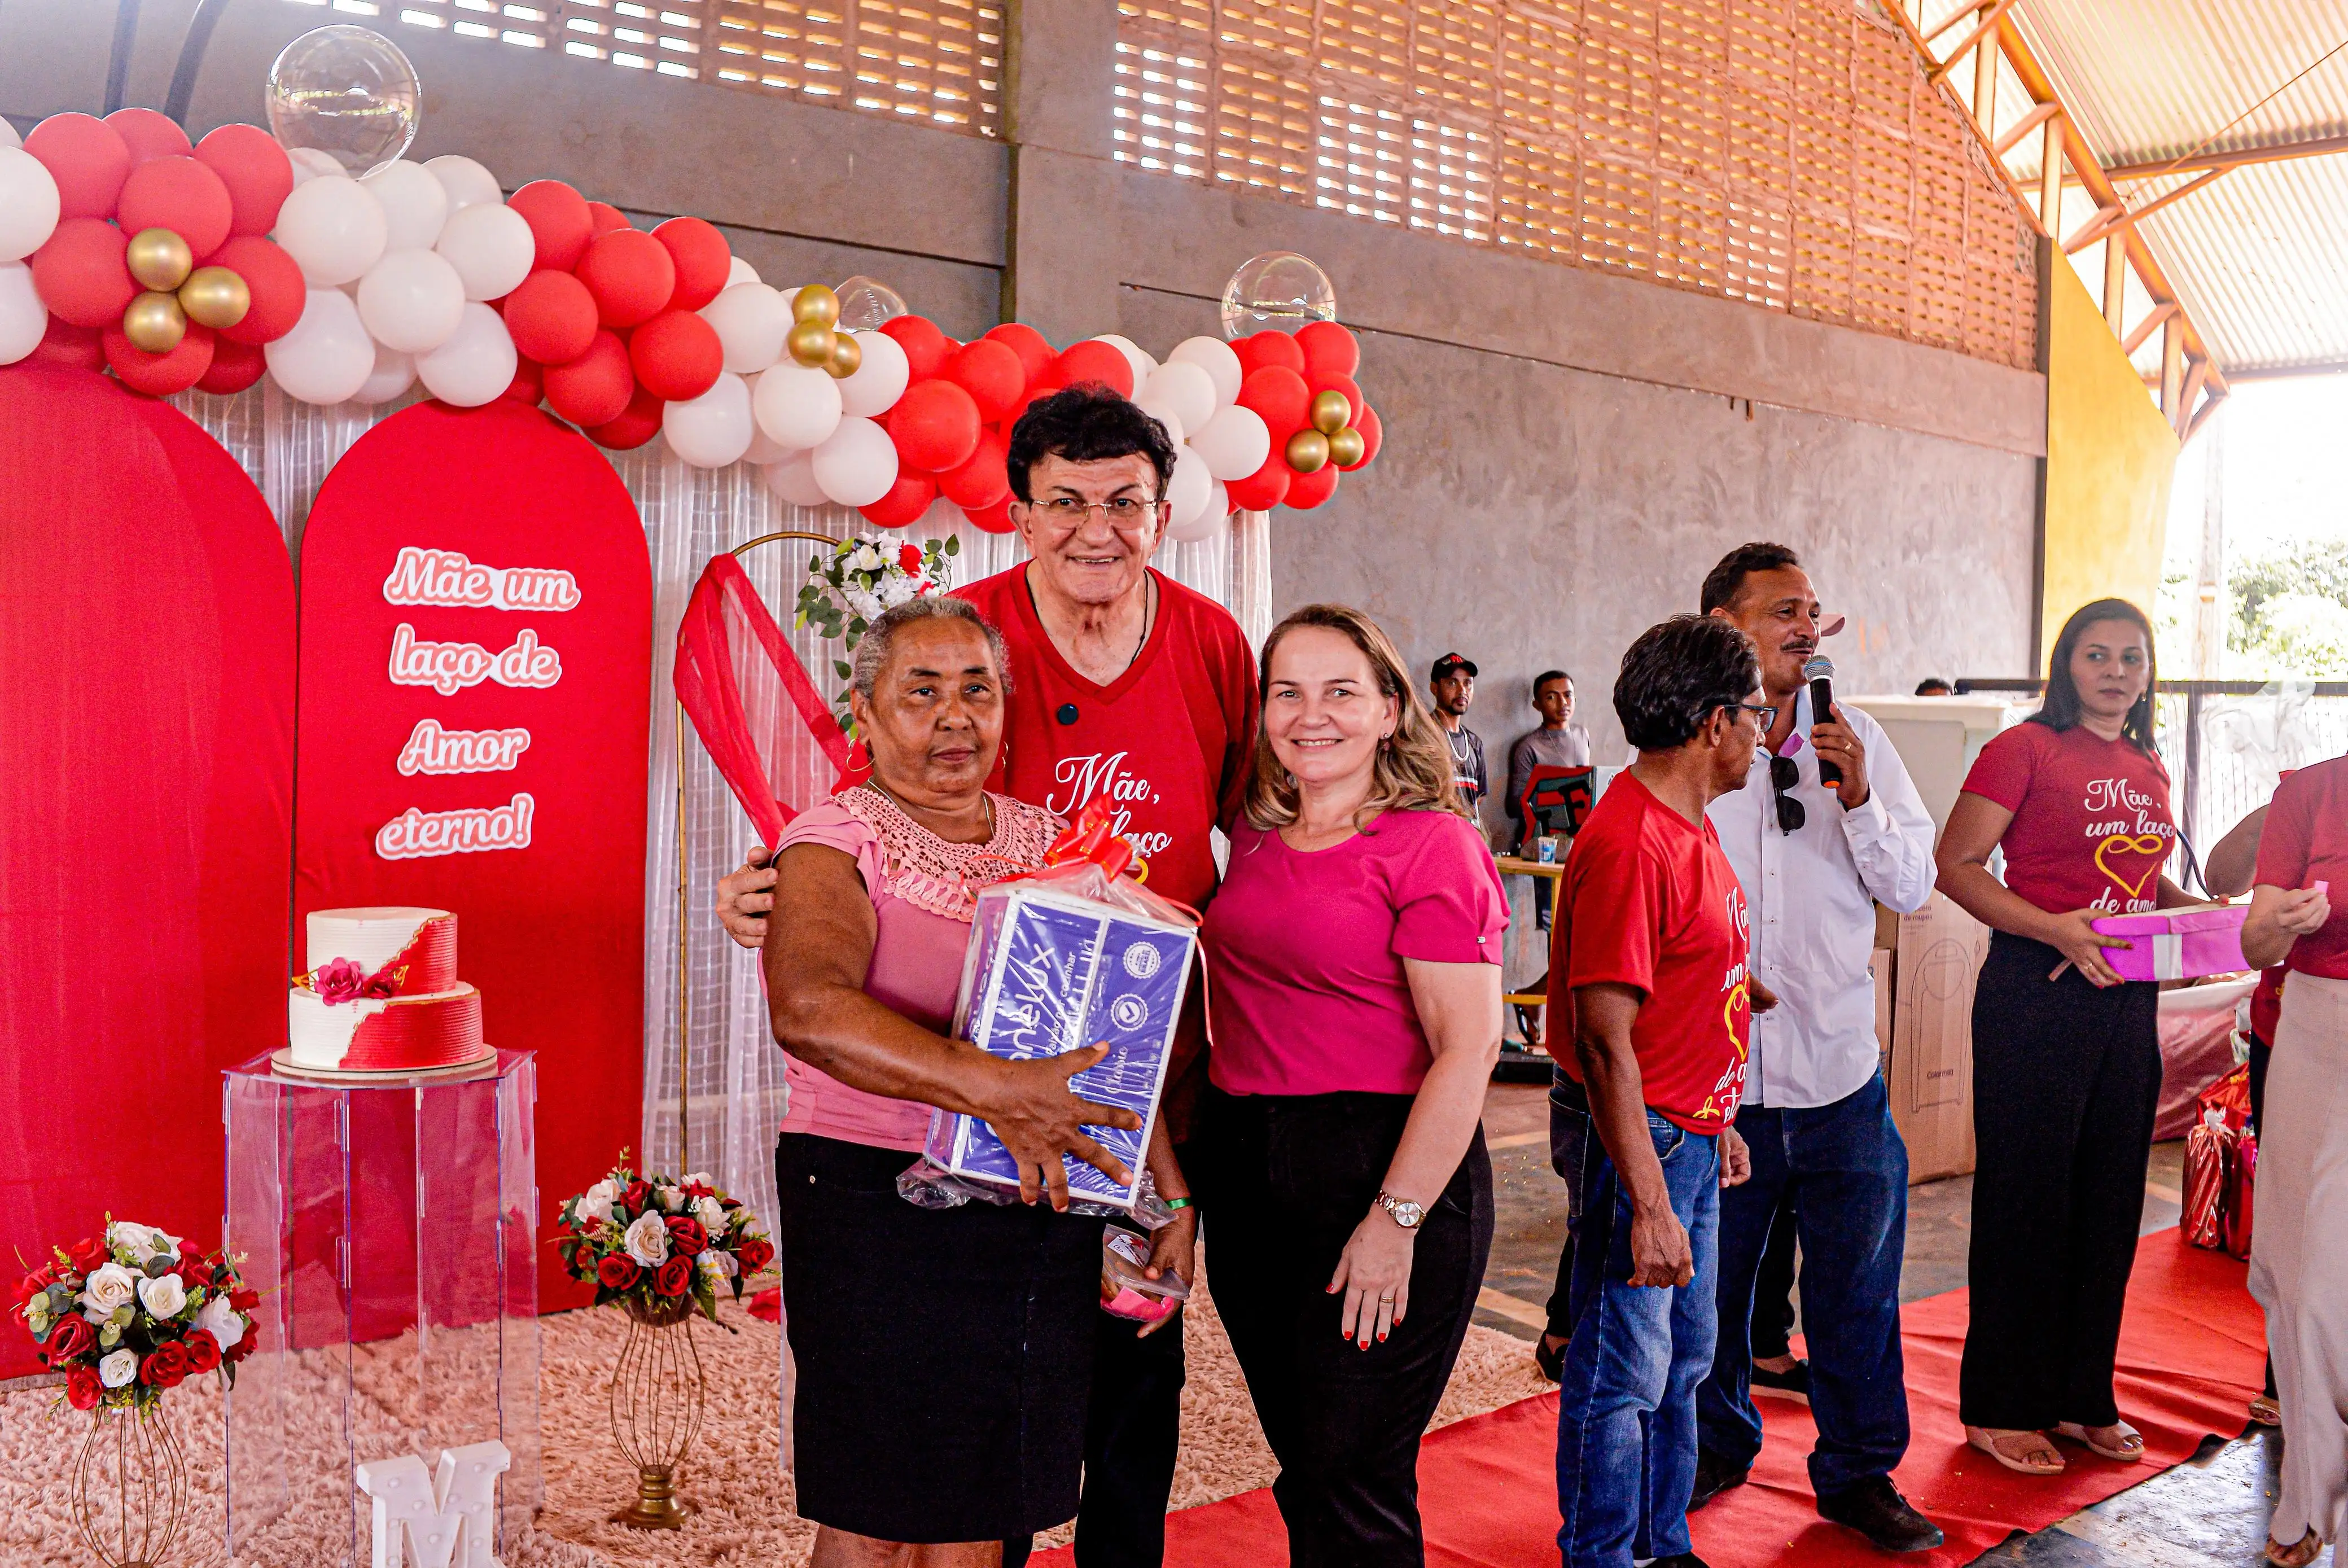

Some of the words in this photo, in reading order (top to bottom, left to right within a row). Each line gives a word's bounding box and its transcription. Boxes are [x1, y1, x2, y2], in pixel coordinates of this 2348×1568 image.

[391, 552, 490, 599] Mãe
[505, 572, 577, 605] um
[395, 628, 489, 688] laço
[505, 633, 557, 681] de
[404, 724, 527, 770] Amor
[382, 800, 527, 849] eterno!
[2086, 821, 2130, 837] um
[2136, 809, 2174, 839] laço
[2090, 886, 2121, 913] de
[2126, 898, 2156, 913] amo
[1009, 943, 1055, 1060] nelux
[1714, 1057, 1736, 1093] de
